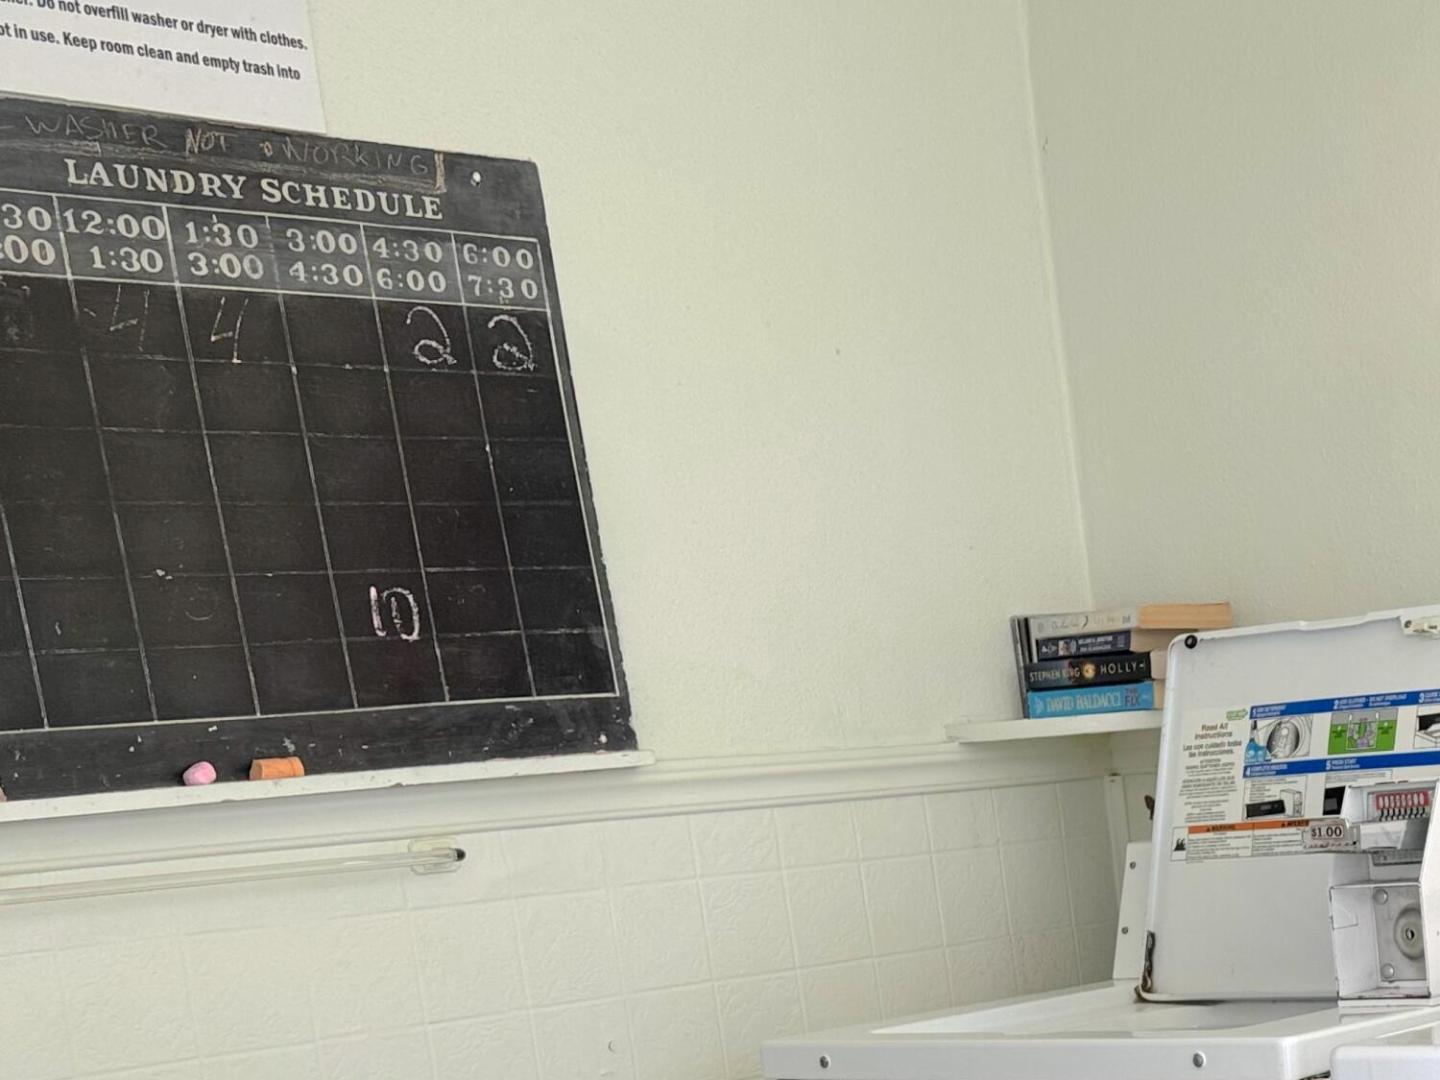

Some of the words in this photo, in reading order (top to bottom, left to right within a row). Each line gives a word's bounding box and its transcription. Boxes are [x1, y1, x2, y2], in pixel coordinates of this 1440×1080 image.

[14, 24, 27, 39] in
[30, 29, 60, 44] use.
[62, 31, 97, 51] Keep
[100, 40, 134, 55] room
[137, 44, 173, 61] clean
[176, 51, 199, 65] and
[202, 55, 240, 74] empty
[242, 59, 275, 77] trash
[277, 64, 301, 80] into
[58, 0, 81, 14] not
[84, 4, 129, 21] overfill
[131, 11, 178, 29] washer
[181, 19, 194, 32] or
[197, 20, 228, 38] dryer
[231, 26, 257, 42] with
[260, 31, 308, 50] clothes.
[25, 114, 168, 149] WASHER
[185, 128, 238, 155] NOT
[64, 158, 247, 199] LAUNDRY
[260, 177, 443, 220] SCHEDULE
[63, 207, 166, 241] 12:00
[185, 221, 259, 249] 1:30
[286, 228, 358, 255] 3:00
[373, 237, 443, 263] 4:30
[462, 243, 534, 270] 6:00
[90, 246, 164, 274] 1:30
[188, 252, 264, 280] 3:00
[289, 261, 364, 287] 4:30
[376, 268, 447, 293] 6:00
[468, 275, 538, 300] 7:30
[406, 305, 457, 365] 2
[1029, 670, 1061, 682] STEPHEN
[1100, 661, 1138, 675] HOLLY
[1311, 826, 1342, 838] $1.00
